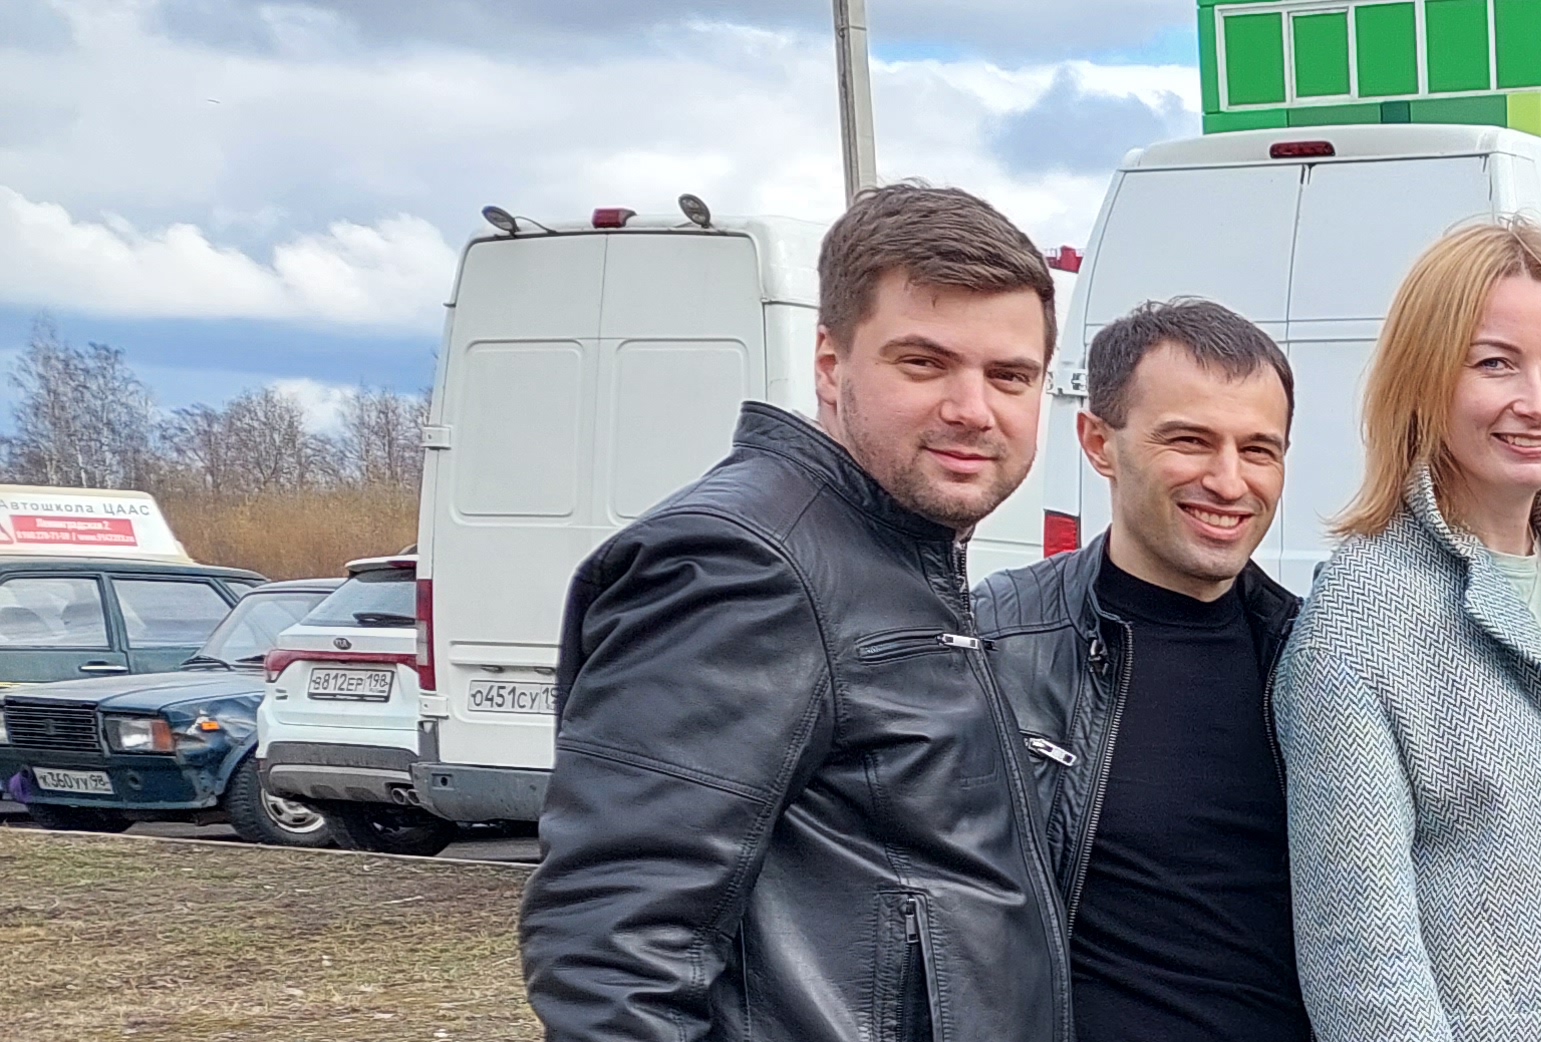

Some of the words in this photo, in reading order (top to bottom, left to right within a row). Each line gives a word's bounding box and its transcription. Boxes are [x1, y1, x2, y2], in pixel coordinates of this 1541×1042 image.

[102, 503, 151, 516] ЦААС
[313, 672, 364, 692] В812ЕР
[366, 673, 387, 688] 198
[472, 684, 540, 710] О451СУ
